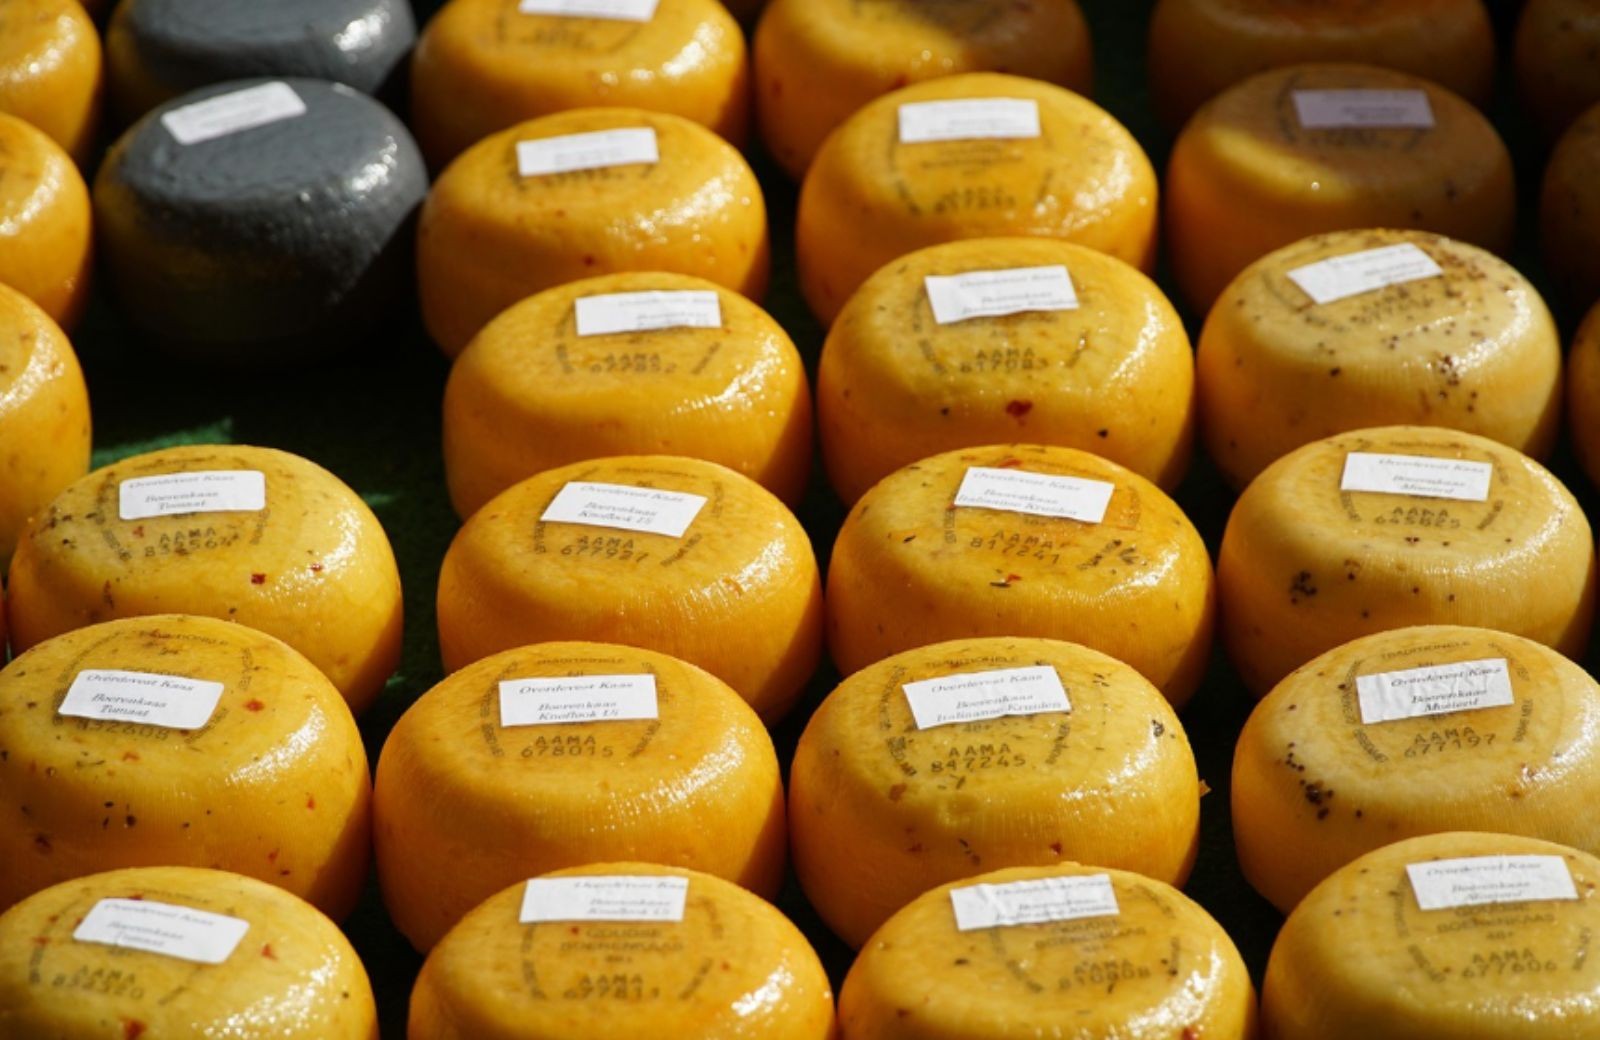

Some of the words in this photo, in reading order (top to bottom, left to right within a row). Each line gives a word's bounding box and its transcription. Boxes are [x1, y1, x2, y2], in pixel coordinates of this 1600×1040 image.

[159, 526, 217, 544] AAMA
[576, 535, 636, 549] AAMA
[992, 530, 1054, 549] AAMA
[931, 677, 1006, 694] Overdevest
[1009, 673, 1044, 685] Kaas
[1391, 670, 1466, 687] Overdevest
[1468, 665, 1504, 678] Kaas
[518, 683, 596, 695] Overdevest
[598, 680, 634, 690] Kaas
[91, 692, 169, 709] Boerenkaas
[956, 693, 1035, 710] Boerenkaas
[1411, 688, 1489, 705] Boerenkaas
[538, 701, 618, 712] Boerenkaas
[1007, 700, 1063, 714] Kruiden
[538, 709, 599, 722] Knoflook
[535, 735, 598, 746] AAMA
[1414, 725, 1477, 745] AAMA
[520, 745, 615, 759] 678015
[948, 742, 1013, 758] AAMA
[1404, 733, 1498, 759] 677197
[930, 754, 1028, 774] 847245
[1472, 947, 1536, 965] AAMA
[579, 973, 645, 986] AAMA
